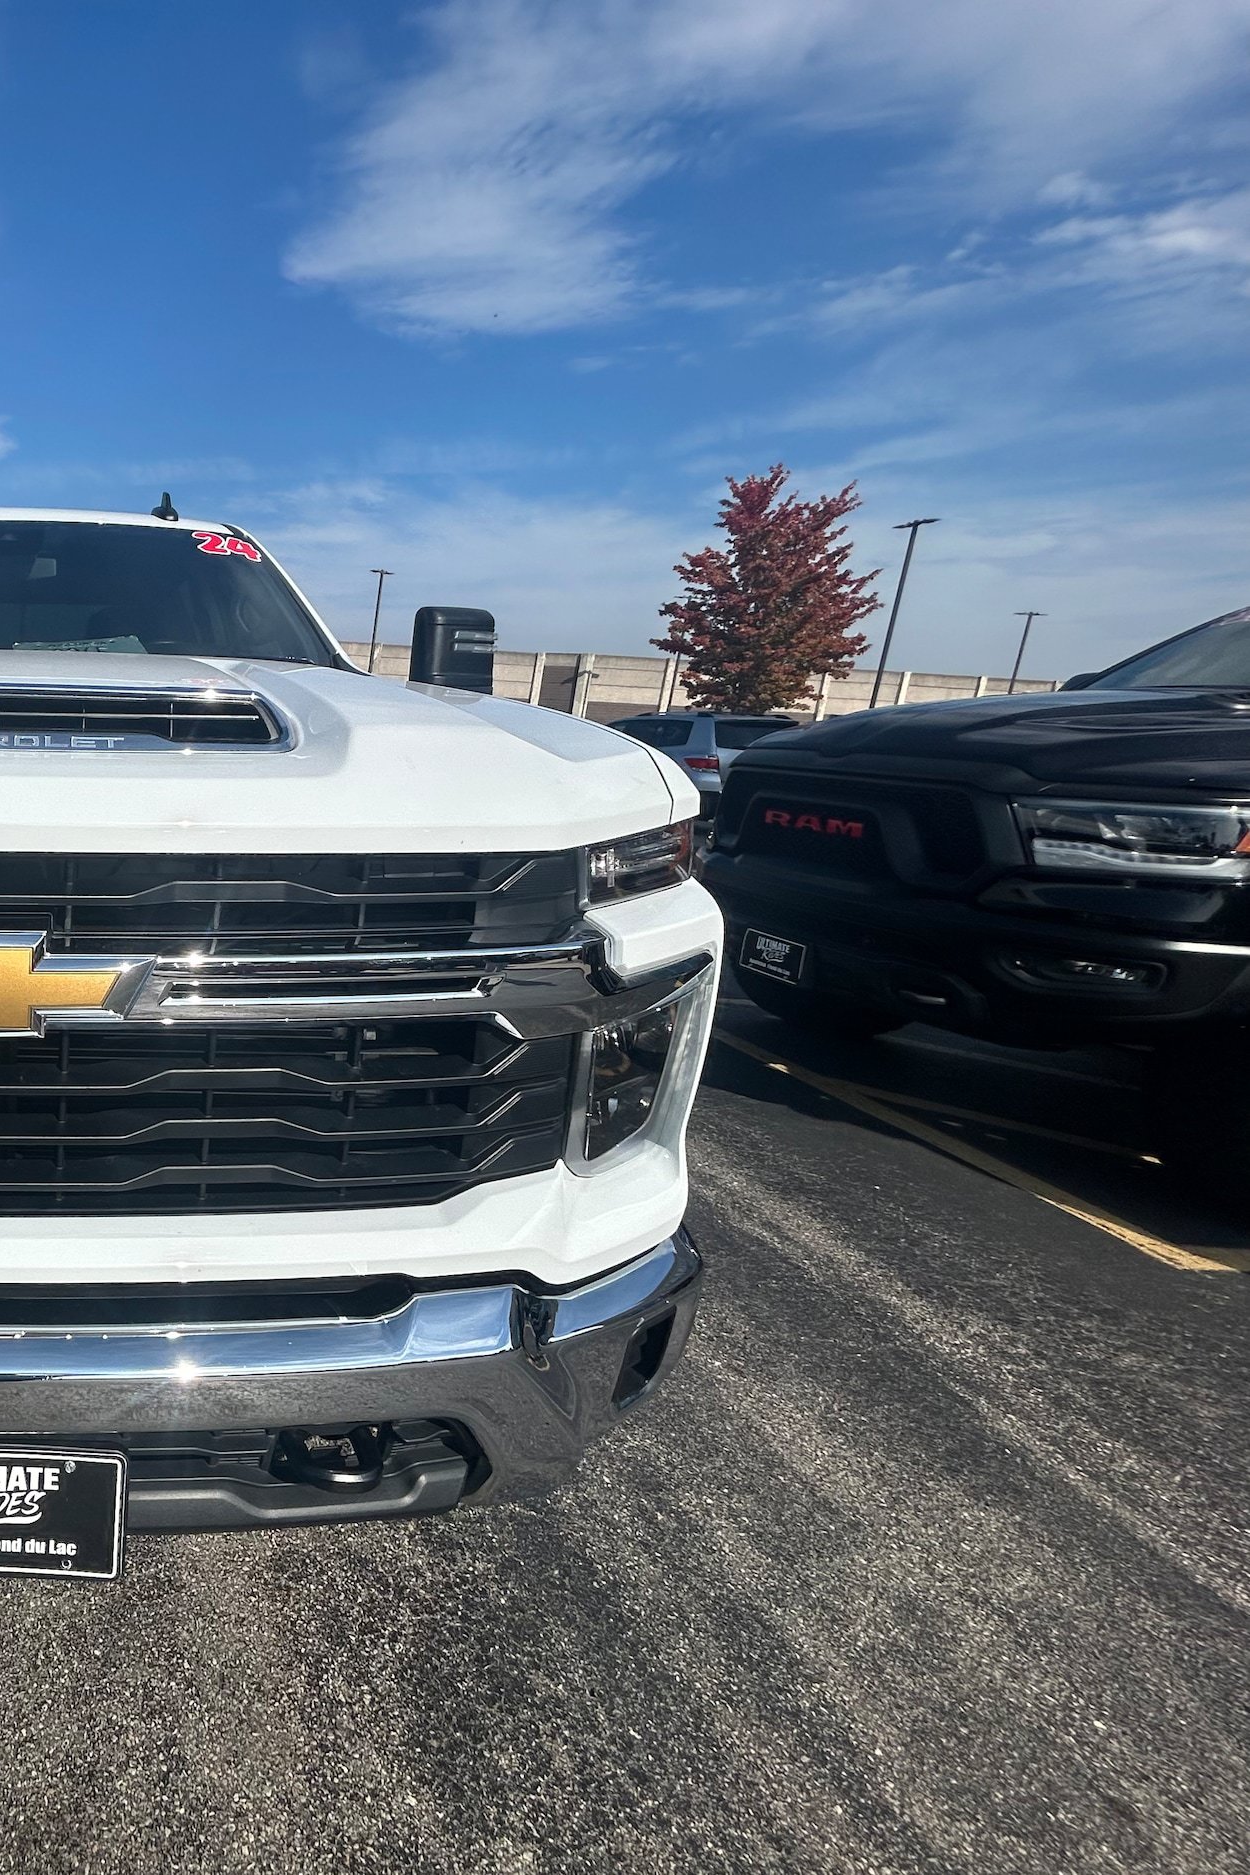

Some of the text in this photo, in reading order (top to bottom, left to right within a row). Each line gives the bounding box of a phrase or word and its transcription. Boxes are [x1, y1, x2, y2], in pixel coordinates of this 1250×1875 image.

[191, 531, 262, 563] 24
[765, 808, 863, 838] RAM
[24, 1538, 46, 1554] du
[48, 1539, 78, 1556] Lac
